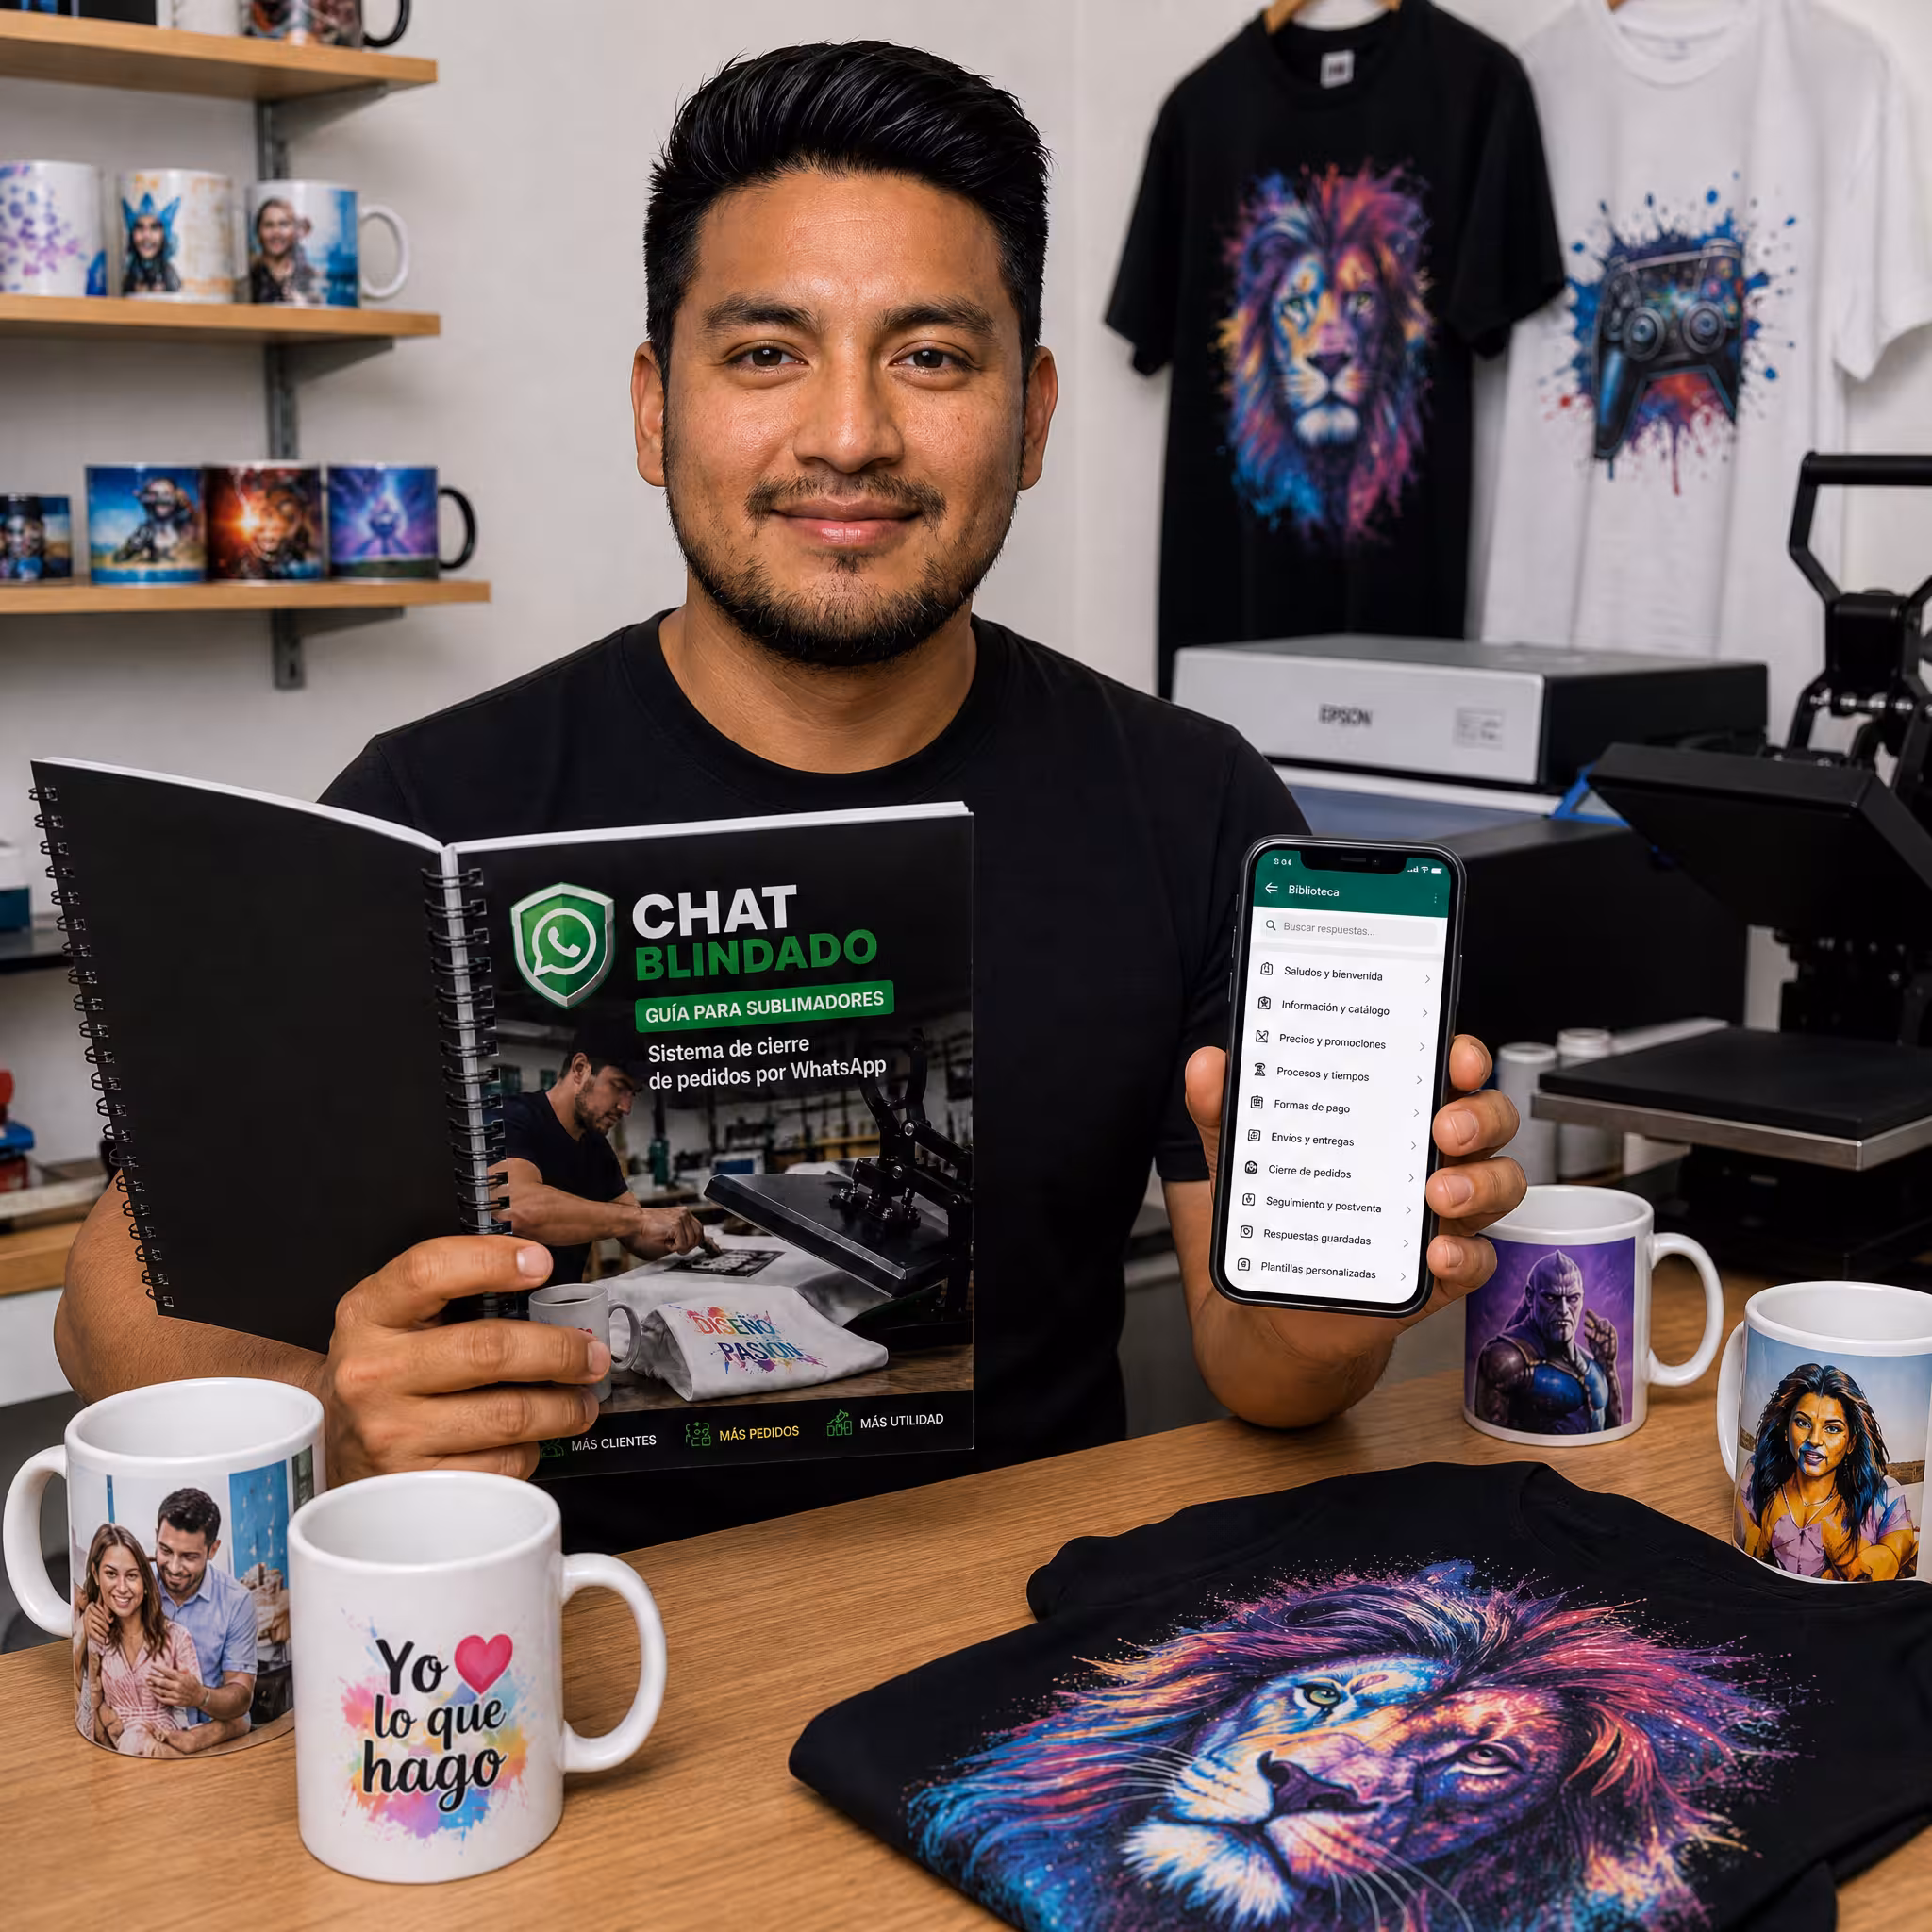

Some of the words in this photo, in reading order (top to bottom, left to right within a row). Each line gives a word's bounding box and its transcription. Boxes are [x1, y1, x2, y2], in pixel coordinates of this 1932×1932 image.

[1288, 885, 1340, 897] Biblioteca
[632, 884, 798, 940] CHAT
[1283, 922, 1315, 932] Buscar
[635, 929, 878, 982] BLINDADO
[1284, 966, 1322, 977] Saludos
[1324, 970, 1330, 980] y
[1332, 969, 1383, 982] bienvenida
[645, 997, 690, 1024] GUÍA
[694, 1002, 741, 1021] PARA
[746, 991, 885, 1016] SUBLIMADORES
[1282, 1000, 1338, 1012] Información
[1340, 1005, 1346, 1015] y
[1348, 1005, 1390, 1018] catálogo
[648, 1042, 724, 1063] Sistema
[728, 1040, 753, 1058] de
[758, 1037, 810, 1056] cierre
[1279, 1033, 1314, 1045] Precios
[1317, 1037, 1324, 1047] y
[1324, 1038, 1386, 1050] promociones
[648, 1072, 673, 1091] de
[677, 1067, 750, 1093] pedidos
[756, 1067, 786, 1089] por
[791, 1058, 887, 1081] WhatsApp
[1276, 1066, 1321, 1078] Procesos
[1323, 1071, 1329, 1081] y
[1331, 1070, 1370, 1083] tiempos
[1274, 1099, 1309, 1110] Formas
[1311, 1102, 1324, 1112] de
[1326, 1105, 1351, 1115] pago
[1305, 1136, 1310, 1145] y
[1312, 1137, 1355, 1148] entregas
[1268, 1164, 1297, 1175] Cierre
[1299, 1167, 1311, 1176] de
[1313, 1168, 1352, 1179] pedidos
[1266, 1196, 1324, 1208] Seguimiento
[1327, 1202, 1333, 1211] y
[1335, 1202, 1382, 1213] postventa
[1263, 1229, 1319, 1241] Respuestas
[1321, 1232, 1372, 1246] guardadas
[1260, 1261, 1304, 1274] Plantillas
[1306, 1264, 1376, 1279] personalizadas
[692, 1315, 775, 1335] DISEÑO
[860, 1415, 887, 1430] MÁS
[890, 1412, 944, 1427] UTILIDAD
[719, 1426, 745, 1442] MÁS
[749, 1424, 800, 1441] PEDIDOS
[571, 1437, 598, 1452] MÁS
[601, 1434, 657, 1449] CLIENTES
[375, 1639, 449, 1695] Yo
[375, 1694, 417, 1739] lo
[427, 1699, 507, 1750] que
[362, 1739, 508, 1812] hago
